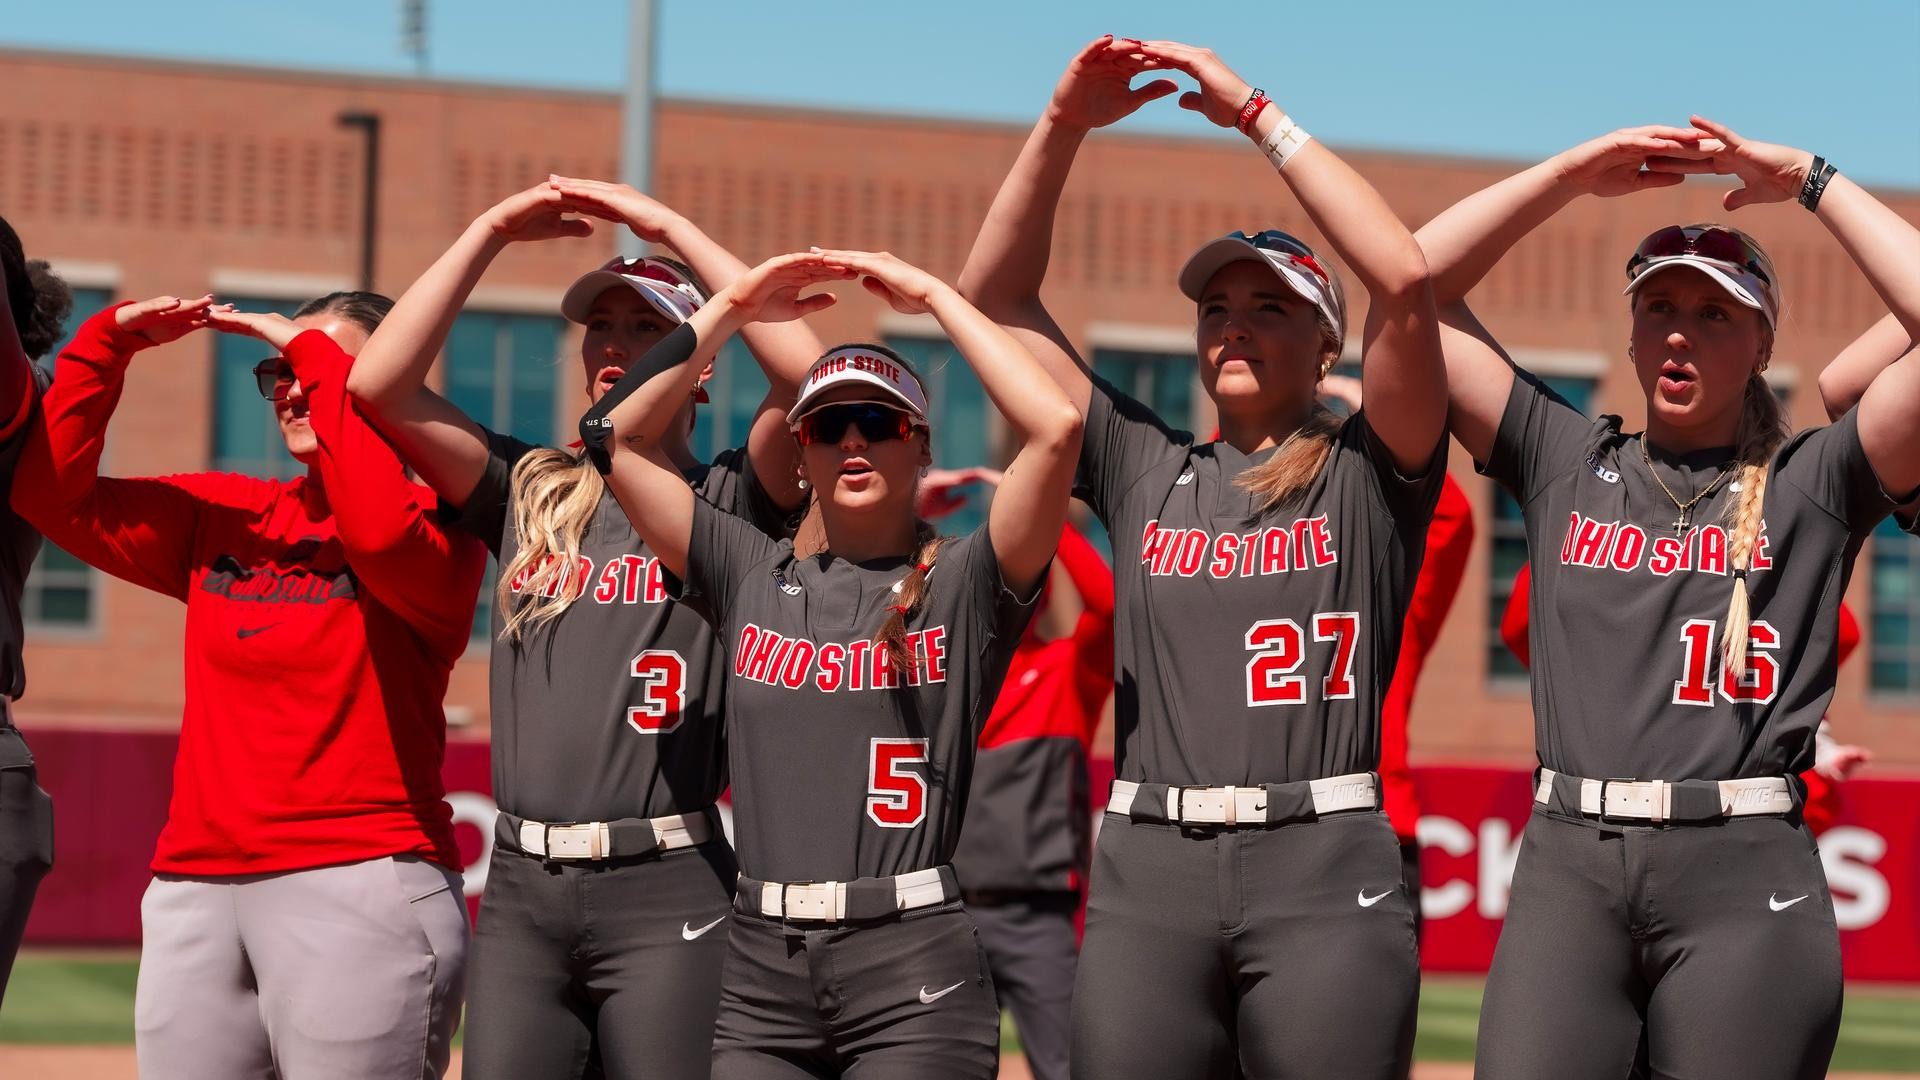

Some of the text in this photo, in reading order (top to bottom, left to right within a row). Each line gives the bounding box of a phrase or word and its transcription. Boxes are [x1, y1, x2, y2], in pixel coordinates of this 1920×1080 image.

[812, 355, 900, 385] OHIO STATE
[1142, 512, 1338, 579] OHIO STATE
[1561, 511, 1647, 573] OHIO
[627, 650, 687, 735] 3
[735, 623, 946, 693] OHIO STATE
[1244, 611, 1361, 707] 27
[1672, 618, 1781, 708] 16
[867, 737, 930, 828] 5
[1732, 786, 1770, 806] NIKE
